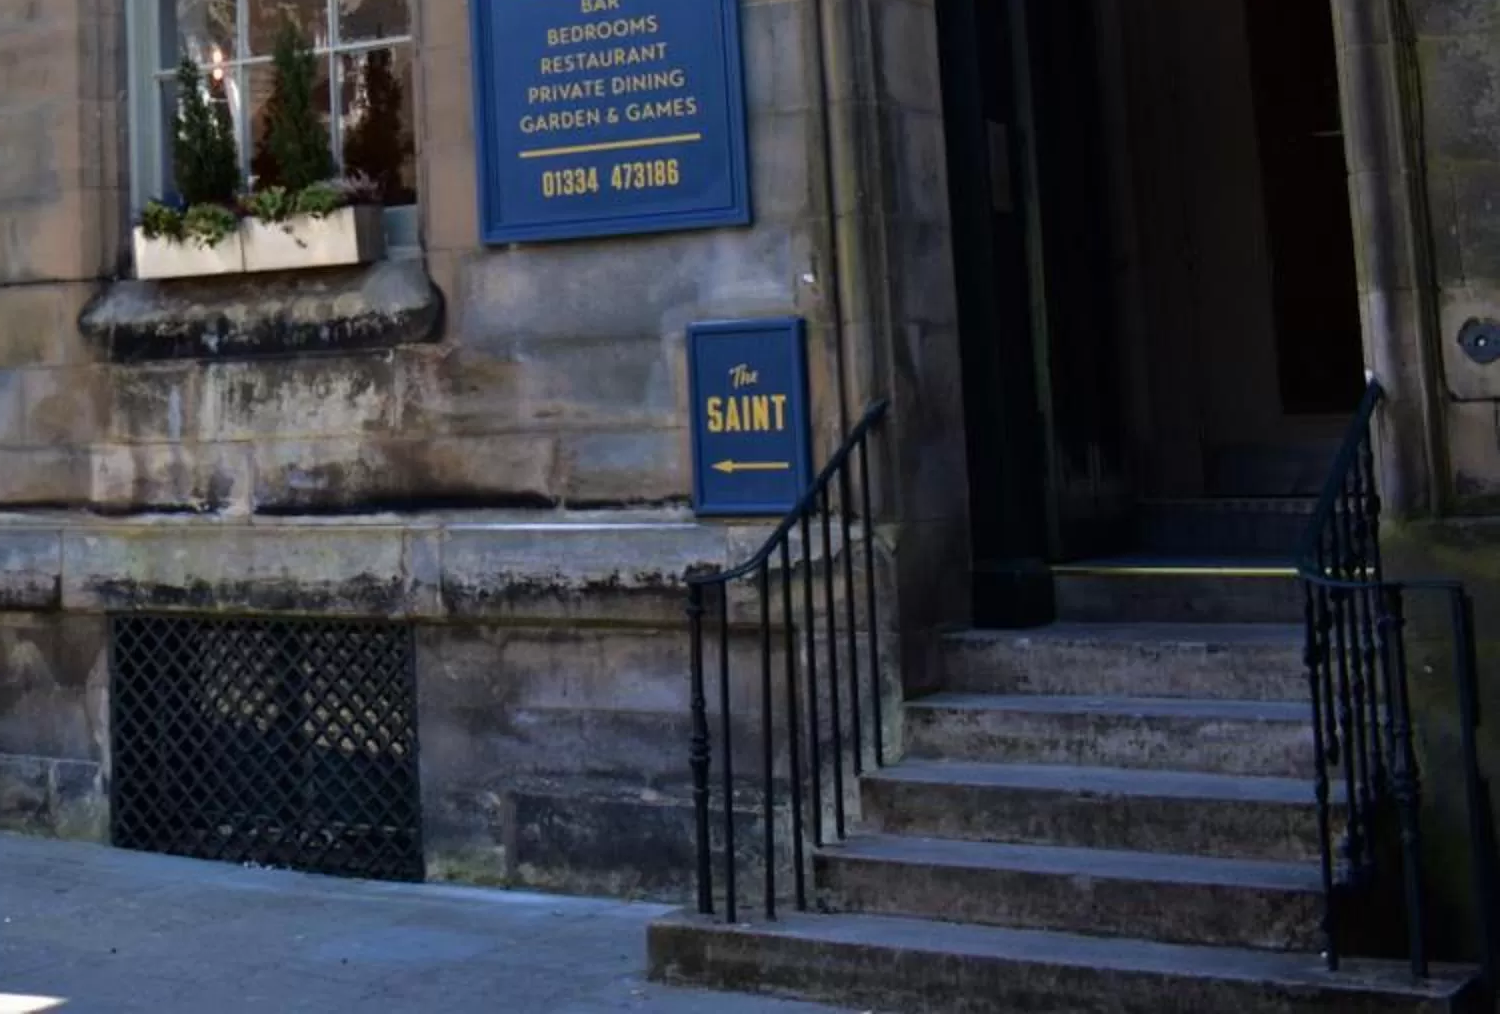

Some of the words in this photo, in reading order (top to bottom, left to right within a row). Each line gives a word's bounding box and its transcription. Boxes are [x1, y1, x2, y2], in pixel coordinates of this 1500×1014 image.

[547, 16, 659, 46] BEDROOMS
[540, 42, 667, 74] RESTAURANT
[528, 79, 605, 105] PRIVATE
[611, 69, 685, 95] DINING
[520, 108, 600, 133] GARDEN
[607, 107, 619, 124] &
[625, 97, 697, 122] GAMES
[542, 167, 599, 198] 01334
[611, 158, 680, 190] 473186
[728, 363, 758, 389] The
[707, 394, 786, 432] SAINT
